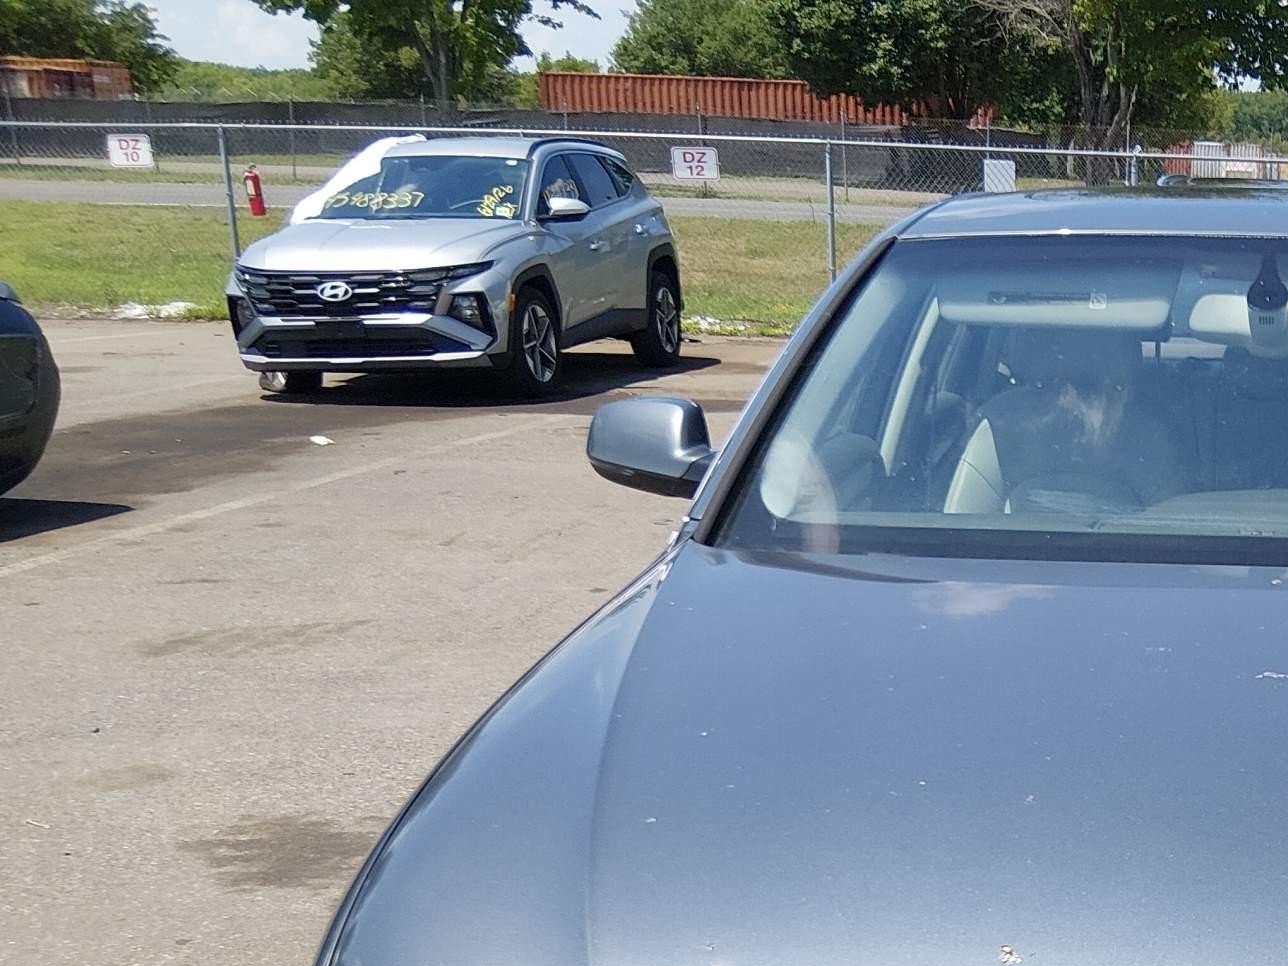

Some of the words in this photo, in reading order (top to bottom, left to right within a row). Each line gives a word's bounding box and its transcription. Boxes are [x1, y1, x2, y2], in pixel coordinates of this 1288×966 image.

[118, 139, 141, 150] DZ
[123, 151, 140, 162] 10
[682, 151, 708, 163] DZ
[686, 165, 705, 176] 12
